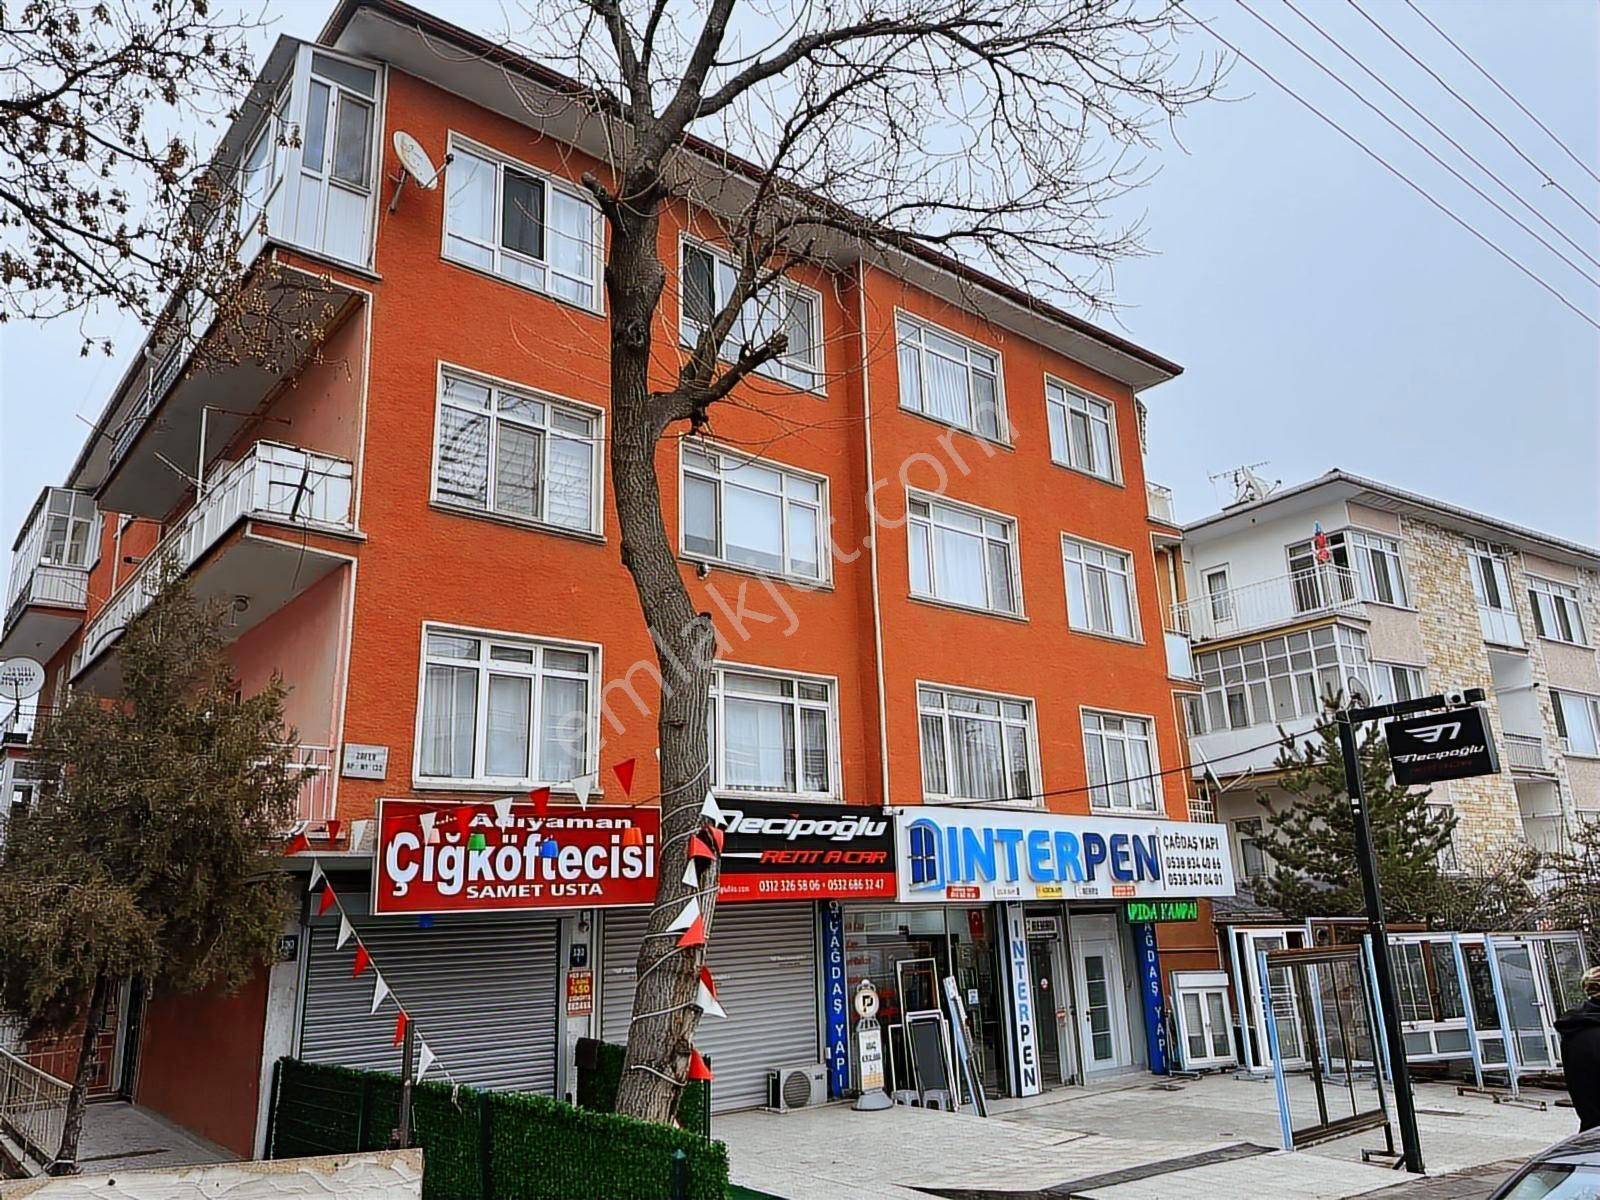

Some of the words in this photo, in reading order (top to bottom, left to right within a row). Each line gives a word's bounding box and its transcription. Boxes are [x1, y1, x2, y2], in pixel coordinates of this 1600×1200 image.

[760, 850, 818, 864] RENT
[842, 850, 887, 864] CAR
[947, 826, 1161, 883] INTERPEN
[1163, 832, 1198, 852] ÇAĞDAŞ
[1199, 836, 1219, 850] YAPI
[467, 884, 543, 899] SAMET
[551, 883, 603, 897] USTA
[759, 880, 778, 892] 0312
[780, 880, 796, 892] 326
[809, 880, 820, 891] 06
[827, 879, 847, 890] 0532
[1012, 919, 1037, 1088] INTERPEN
[835, 1023, 845, 1088] YAPI
[1154, 1006, 1166, 1068] YAPI
